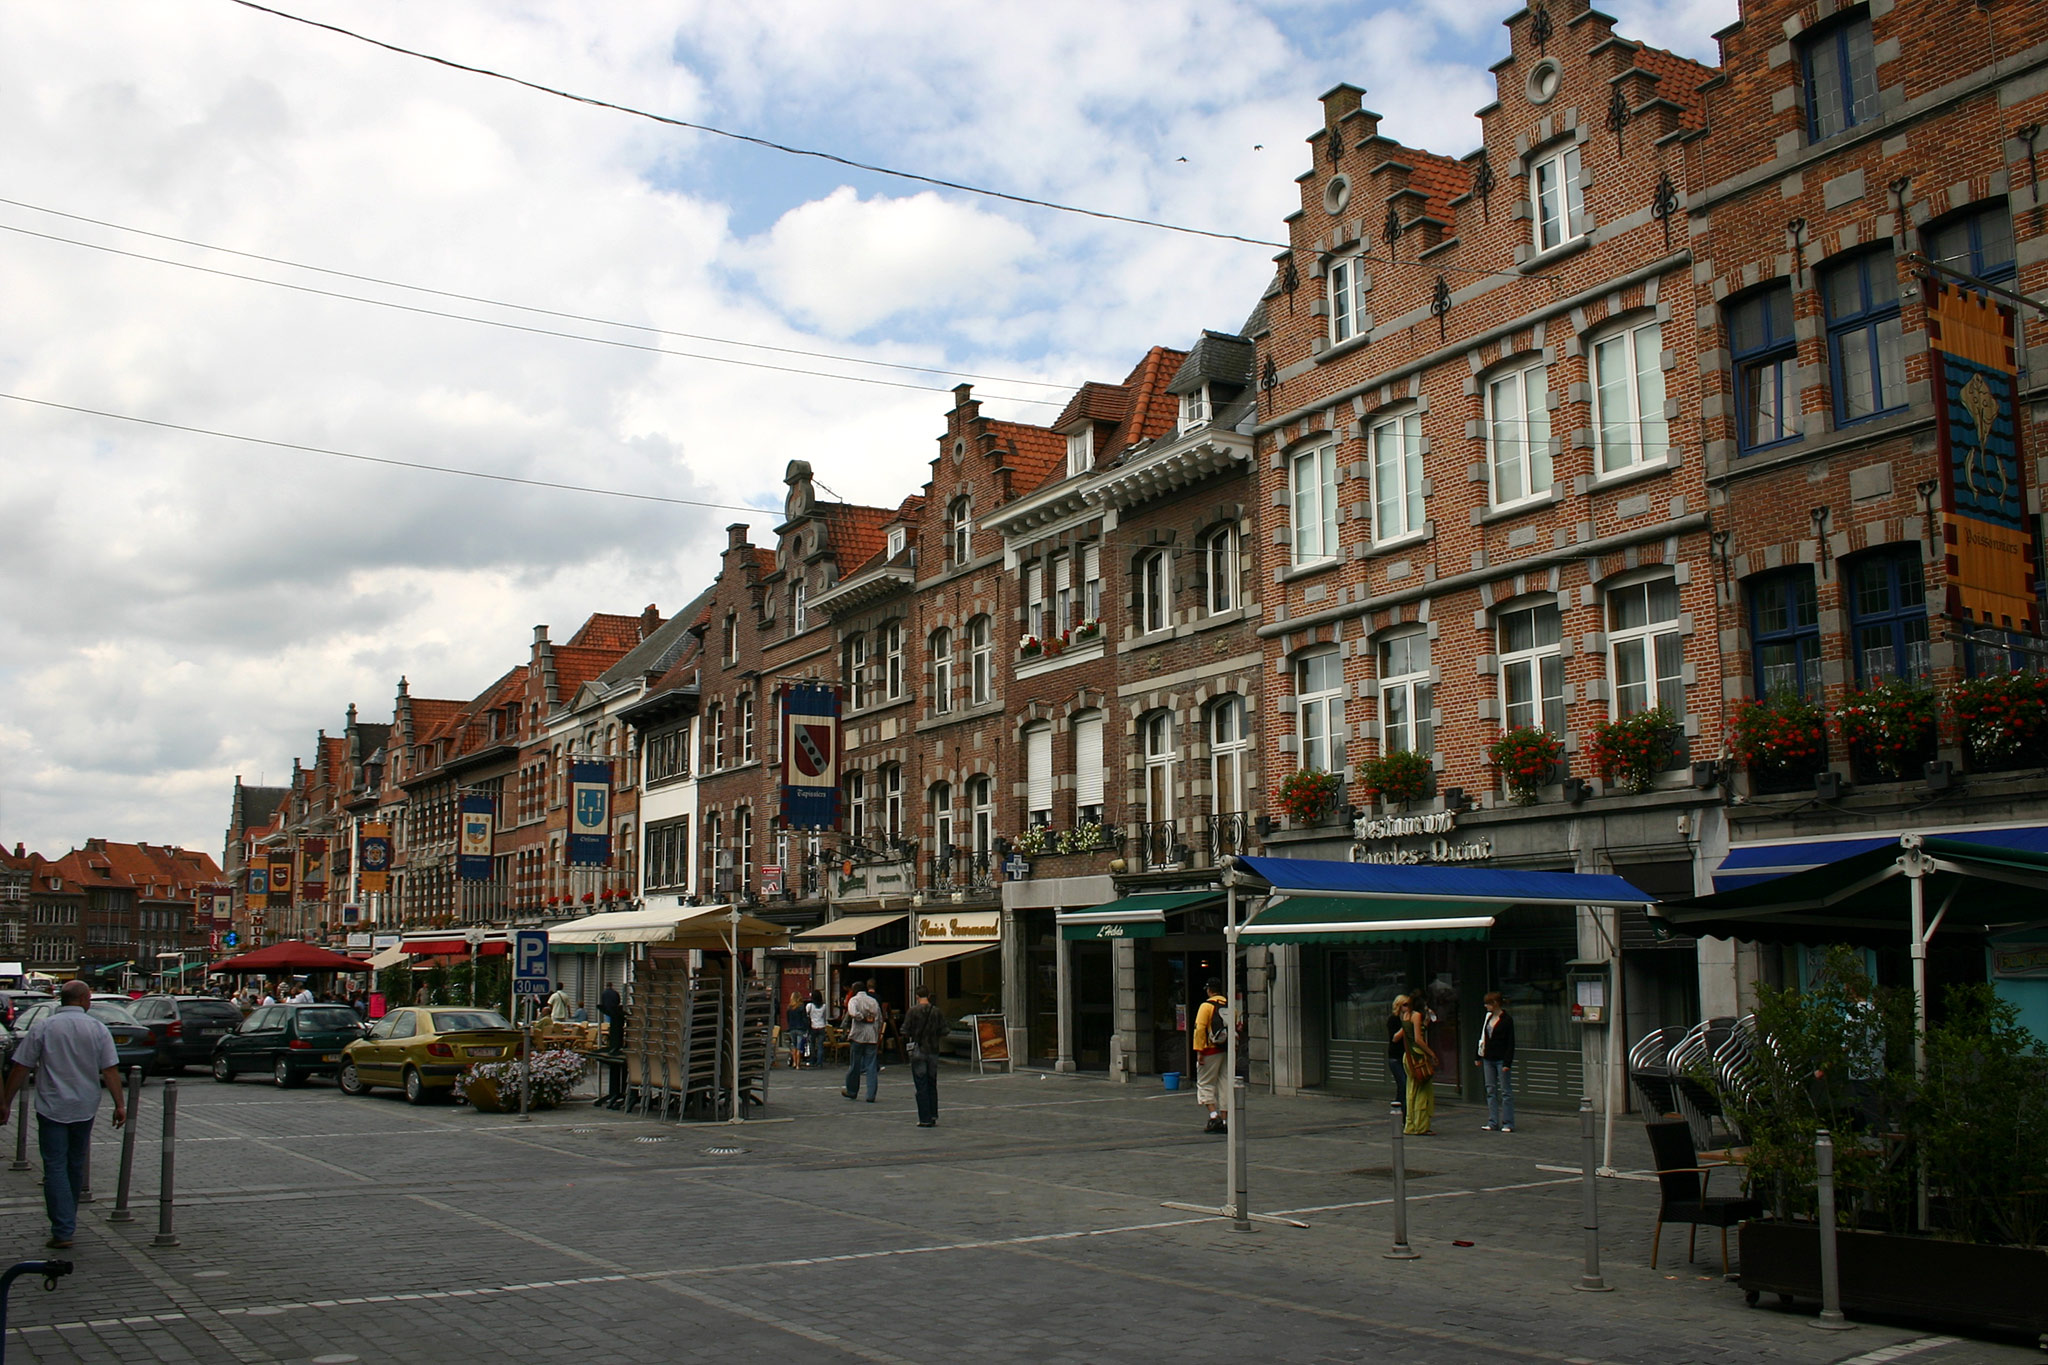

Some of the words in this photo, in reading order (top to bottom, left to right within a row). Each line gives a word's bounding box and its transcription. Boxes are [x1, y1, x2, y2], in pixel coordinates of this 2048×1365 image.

[1964, 527, 2018, 555] Poissonniers
[1353, 809, 1456, 840] Restaurant
[918, 918, 947, 937] Plaisir
[949, 917, 999, 937] Gourmand
[520, 937, 545, 971] P
[517, 980, 531, 993] 30
[532, 983, 545, 993] MIN
